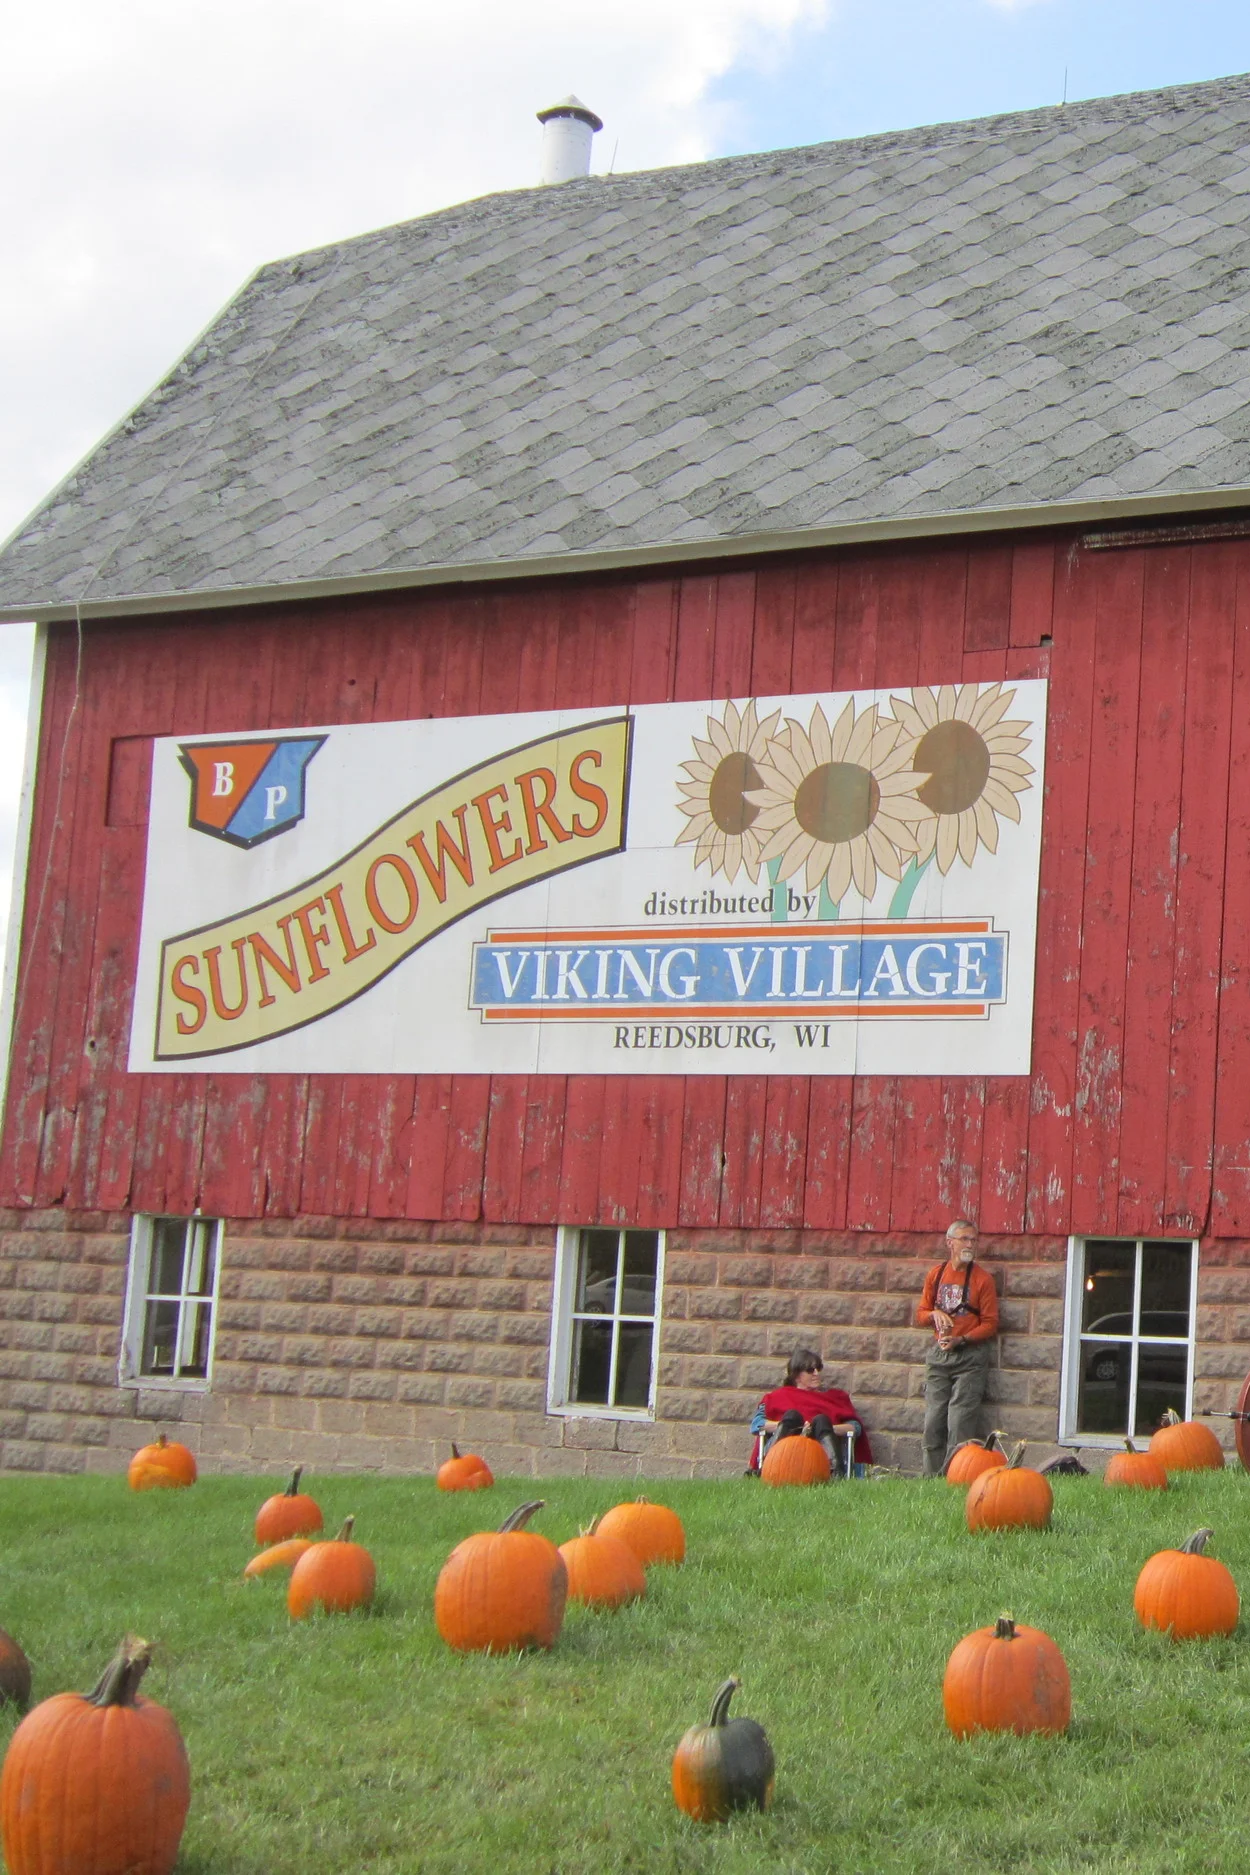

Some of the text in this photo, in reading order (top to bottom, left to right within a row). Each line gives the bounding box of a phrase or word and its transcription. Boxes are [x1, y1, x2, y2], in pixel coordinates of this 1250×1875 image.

[212, 762, 287, 820] B P
[171, 749, 609, 1035] SUNFLOWERS
[643, 888, 817, 919] distributed by
[491, 941, 988, 1000] VIKING VILLAGE
[613, 1024, 831, 1054] REEDSBURG, WI
